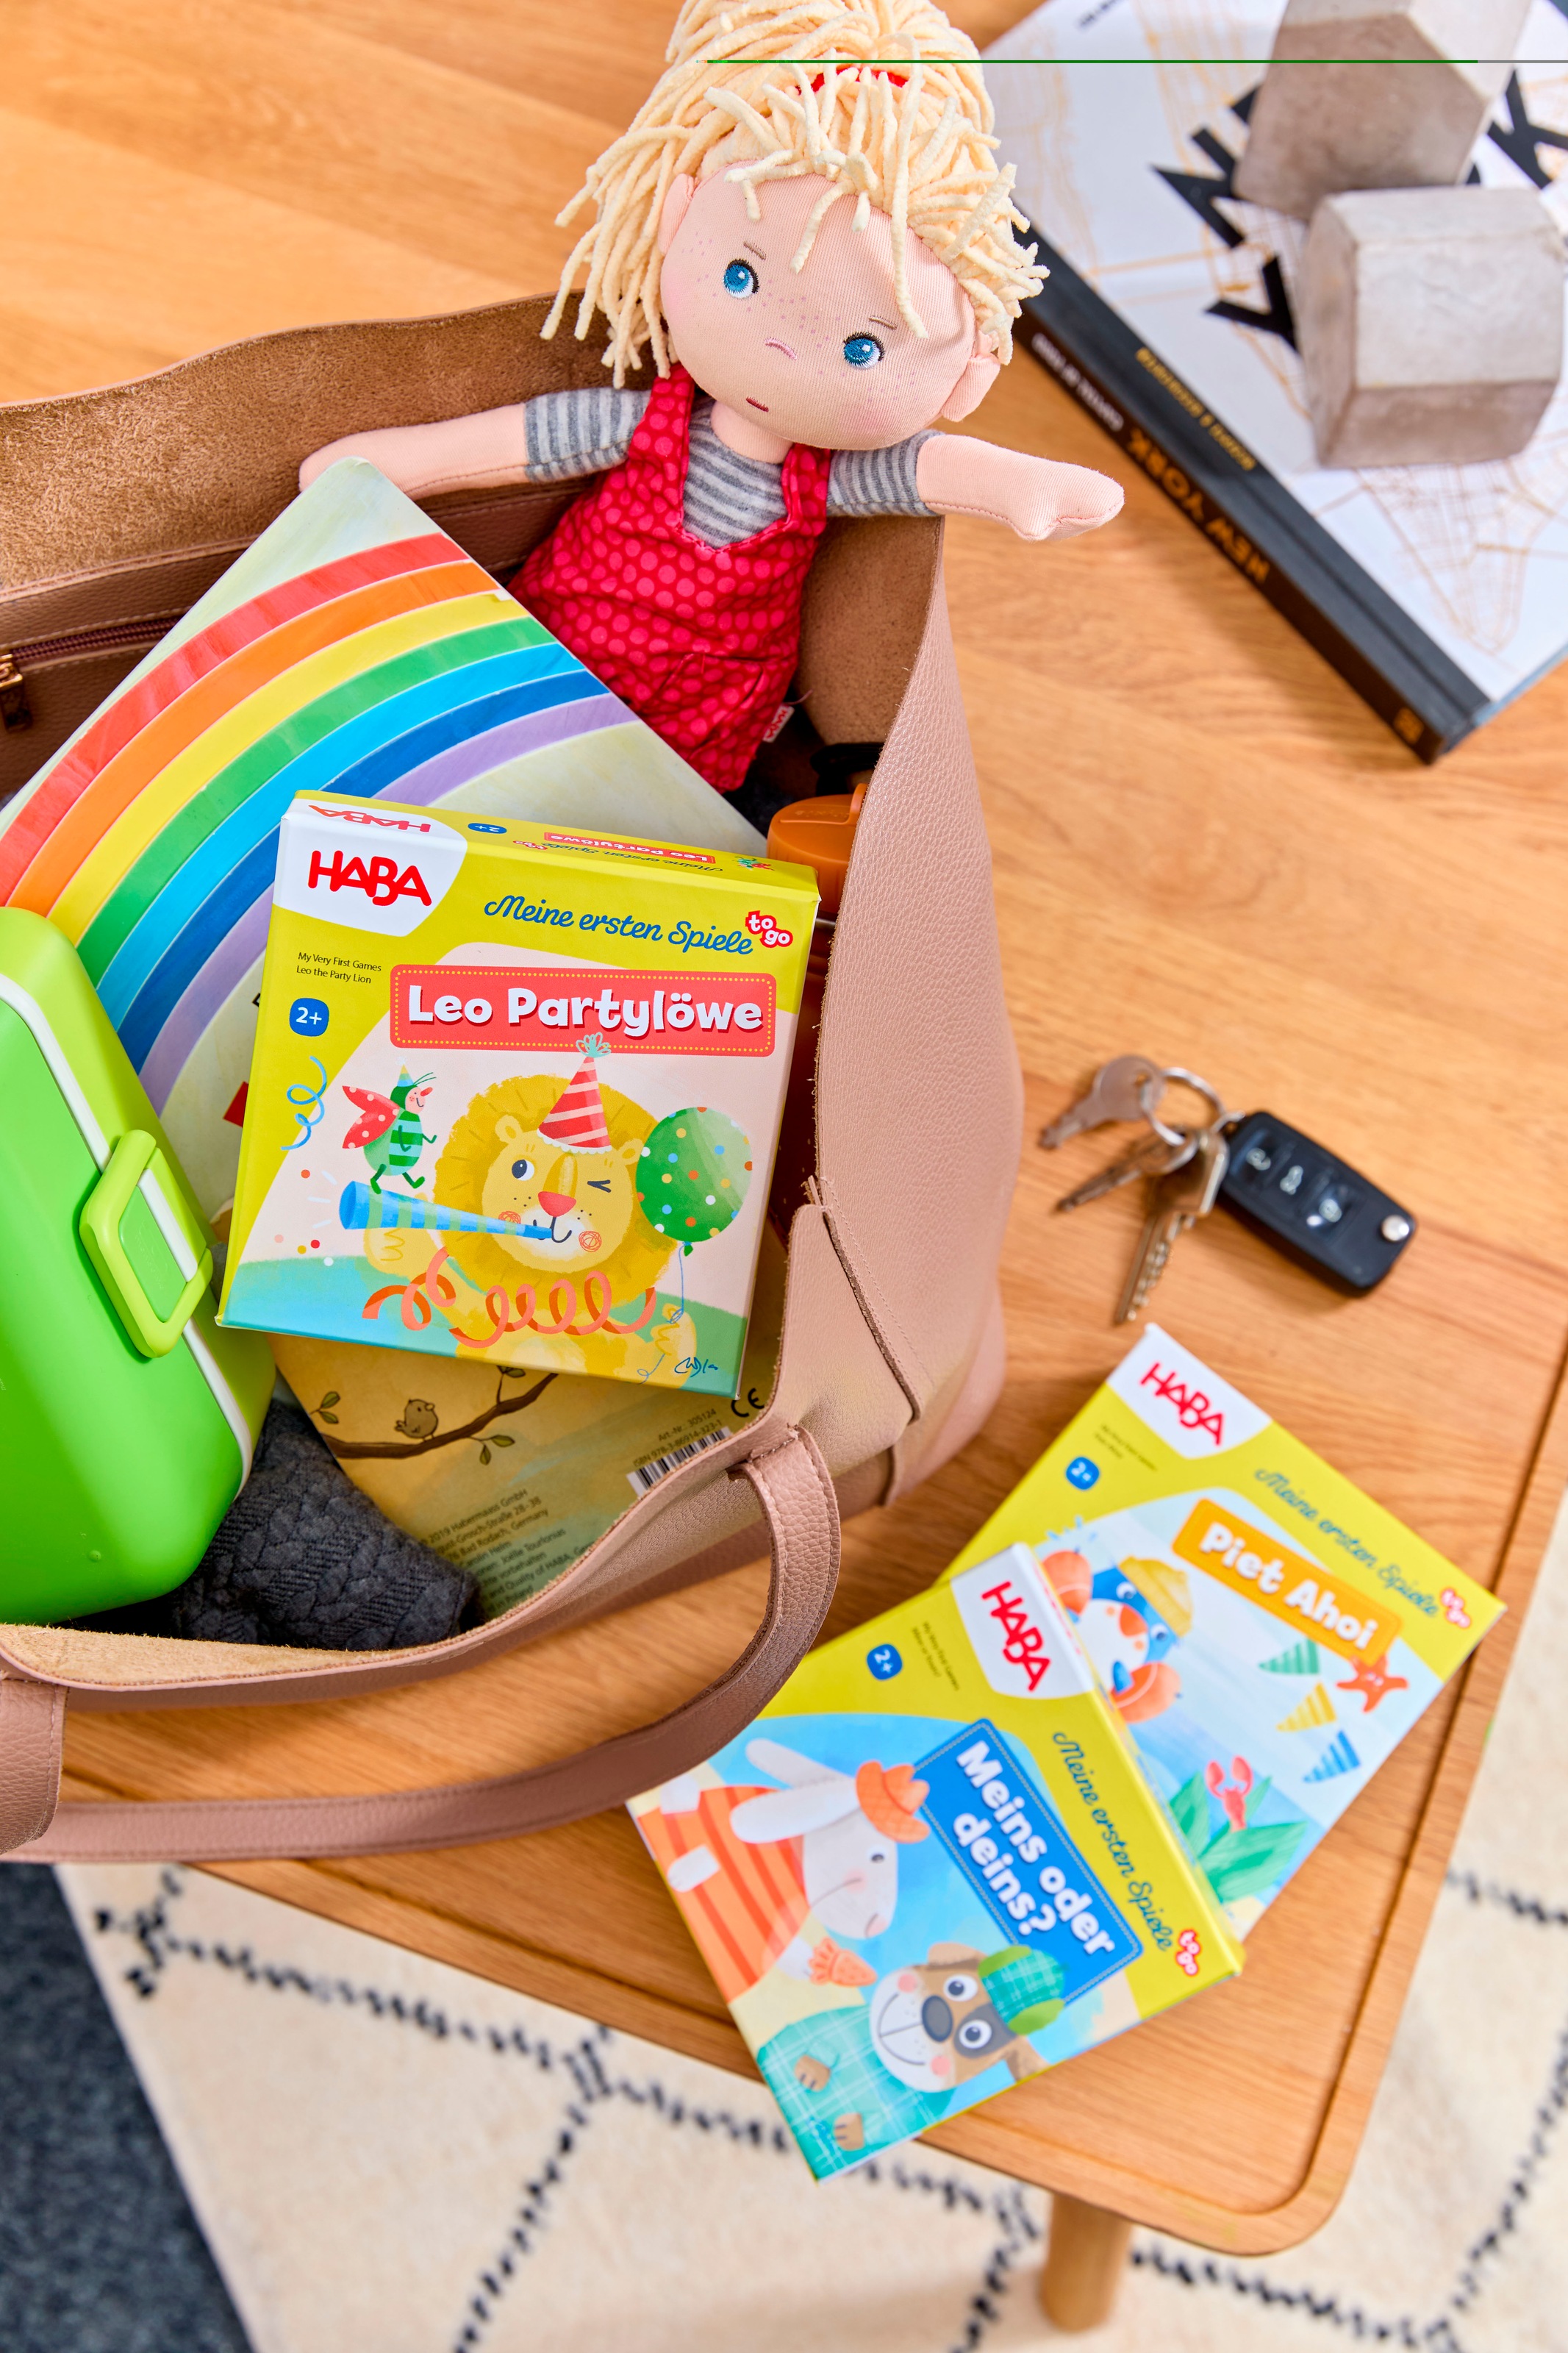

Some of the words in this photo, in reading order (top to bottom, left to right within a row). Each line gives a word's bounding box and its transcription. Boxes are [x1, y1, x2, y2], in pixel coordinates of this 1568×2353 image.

[1124, 431, 1211, 517] YORK
[1207, 515, 1272, 581] NEW
[308, 805, 432, 832] HABA
[475, 824, 500, 833] 2+
[541, 843, 599, 853] Spiele
[551, 835, 664, 854] Partylöwe
[602, 851, 660, 862] ersten
[670, 851, 707, 861] Leo
[307, 850, 432, 907] HABA
[662, 860, 723, 871] Meine
[484, 895, 574, 927] Meine
[579, 913, 663, 942] ersten
[667, 921, 754, 954] Spiele
[748, 913, 773, 931] to
[764, 929, 791, 946] go
[296, 965, 312, 975] Leo
[314, 968, 329, 977] the
[329, 970, 351, 982] Party
[353, 973, 371, 984] Lion
[298, 952, 311, 963] My
[312, 954, 331, 966] Very
[333, 957, 351, 967] First
[352, 960, 382, 971] Games
[296, 1007, 322, 1025] 2+
[409, 985, 493, 1024] Leo
[507, 987, 763, 1038] Partylöwe
[687, 1407, 717, 1427] 305124
[1139, 1362, 1223, 1446] HABA
[633, 1454, 651, 1468] ISBN
[652, 1420, 720, 1457] 978-3-86914-323-1
[429, 1527, 451, 1543] 2019
[451, 1503, 500, 1532] Habermaass
[500, 1488, 527, 1507] GmbH
[459, 1543, 476, 1556] Bad
[476, 1526, 509, 1548] Rodach,
[511, 1507, 549, 1530] Germany
[1253, 1468, 1320, 1522] Meine
[1318, 1518, 1378, 1568] ersten
[1377, 1563, 1439, 1618] Spiele
[499, 1552, 546, 1579] vorbehalten
[489, 1586, 506, 1599] and
[505, 1571, 536, 1591] Quality
[534, 1565, 547, 1575] of
[506, 1585, 534, 1603] Poland
[1198, 1521, 1285, 1594] Piet
[1284, 1579, 1379, 1651] Ahoi
[981, 1581, 1050, 1691] HABA
[873, 1649, 894, 1674] 2+
[956, 1740, 1048, 1863] Meins
[1039, 1865, 1116, 1955] oder
[1052, 1731, 1098, 1807] Meine
[1092, 1807, 1136, 1879] ersten
[1127, 1880, 1174, 1952] Spiele
[952, 1812, 1057, 1936] deins?
[1178, 1931, 1200, 1956] to
[1176, 1950, 1199, 1977] go
